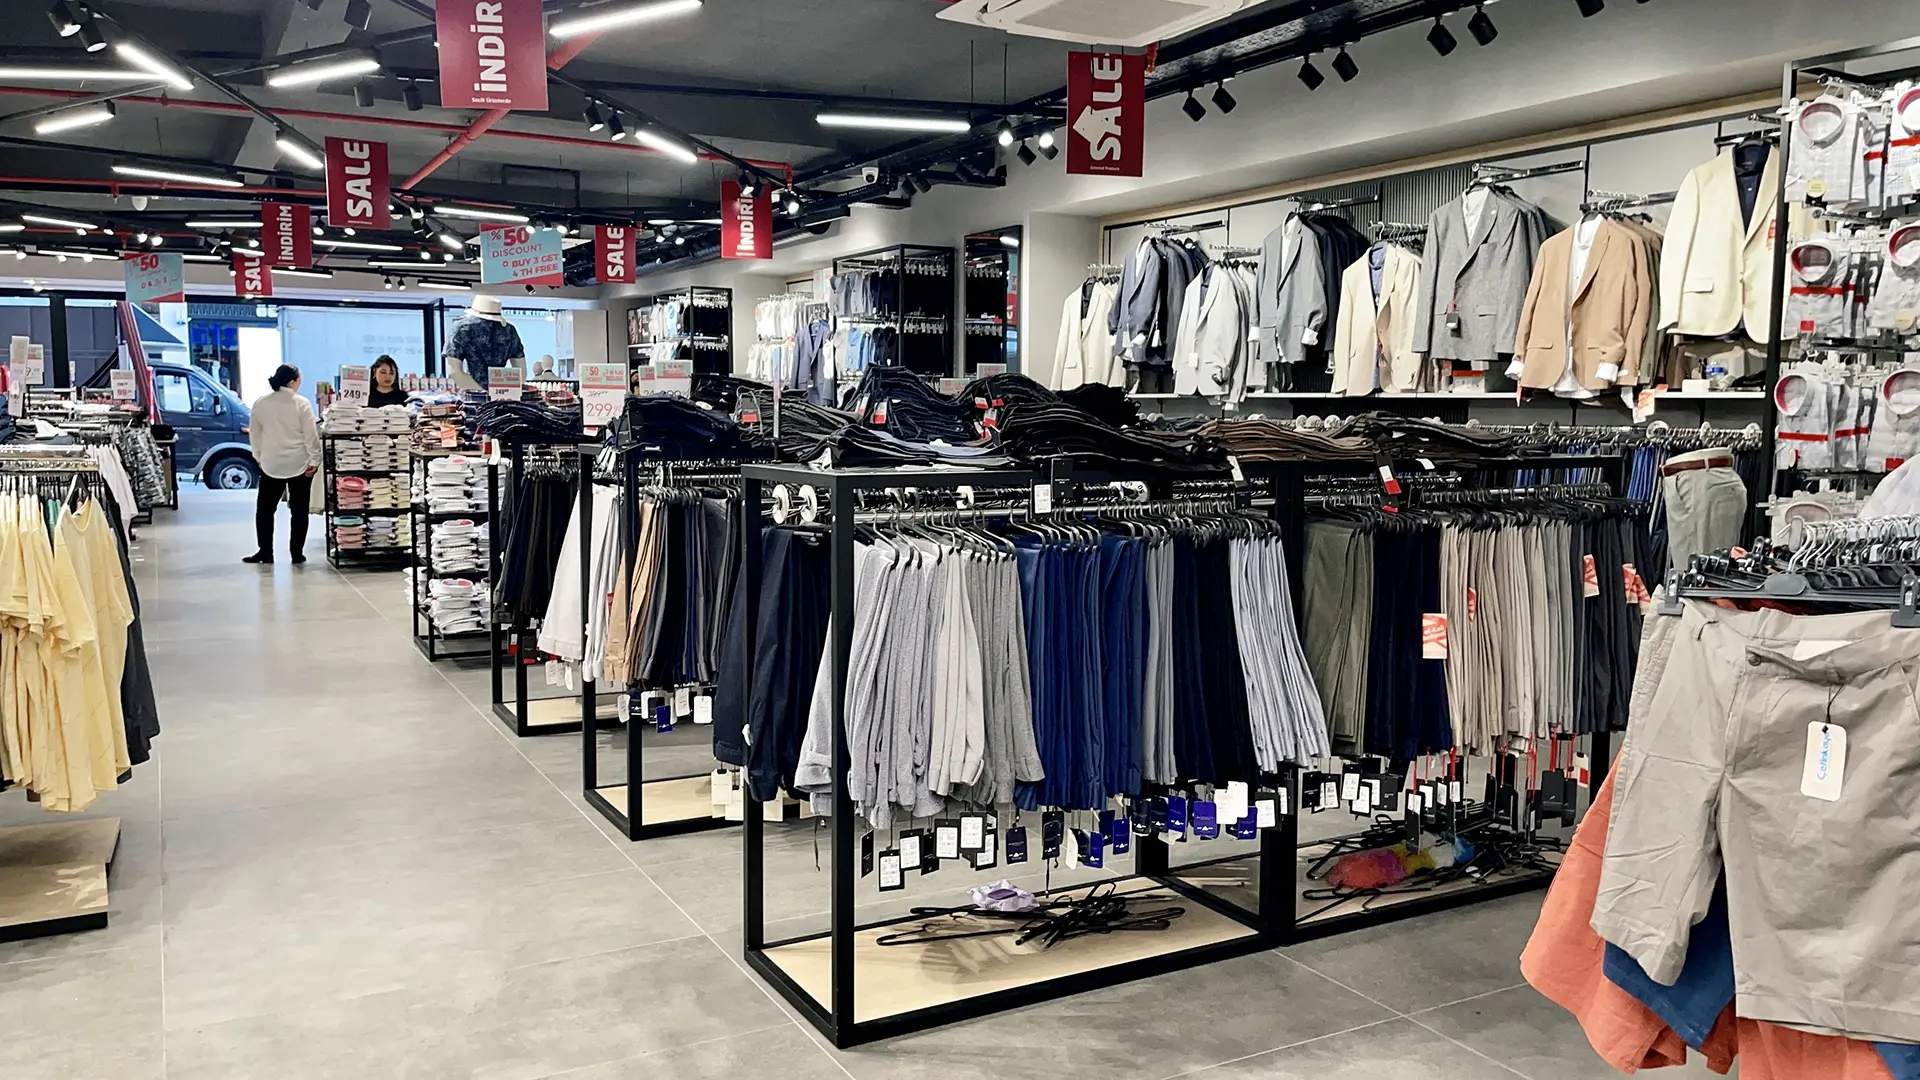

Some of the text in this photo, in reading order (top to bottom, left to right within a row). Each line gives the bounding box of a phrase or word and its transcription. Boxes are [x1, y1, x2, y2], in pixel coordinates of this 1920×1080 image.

[1089, 57, 1122, 160] SALE
[343, 141, 373, 218] SALE
[276, 205, 294, 261] İNDİRİM
[492, 243, 543, 258] DISCOUNT
[607, 227, 624, 277] SALE
[512, 258, 531, 268] BUY
[533, 256, 539, 264] 3
[541, 253, 559, 262] GET
[520, 268, 533, 276] TH
[535, 264, 558, 273] FREE
[343, 389, 361, 399] 249
[586, 403, 613, 417] 299
